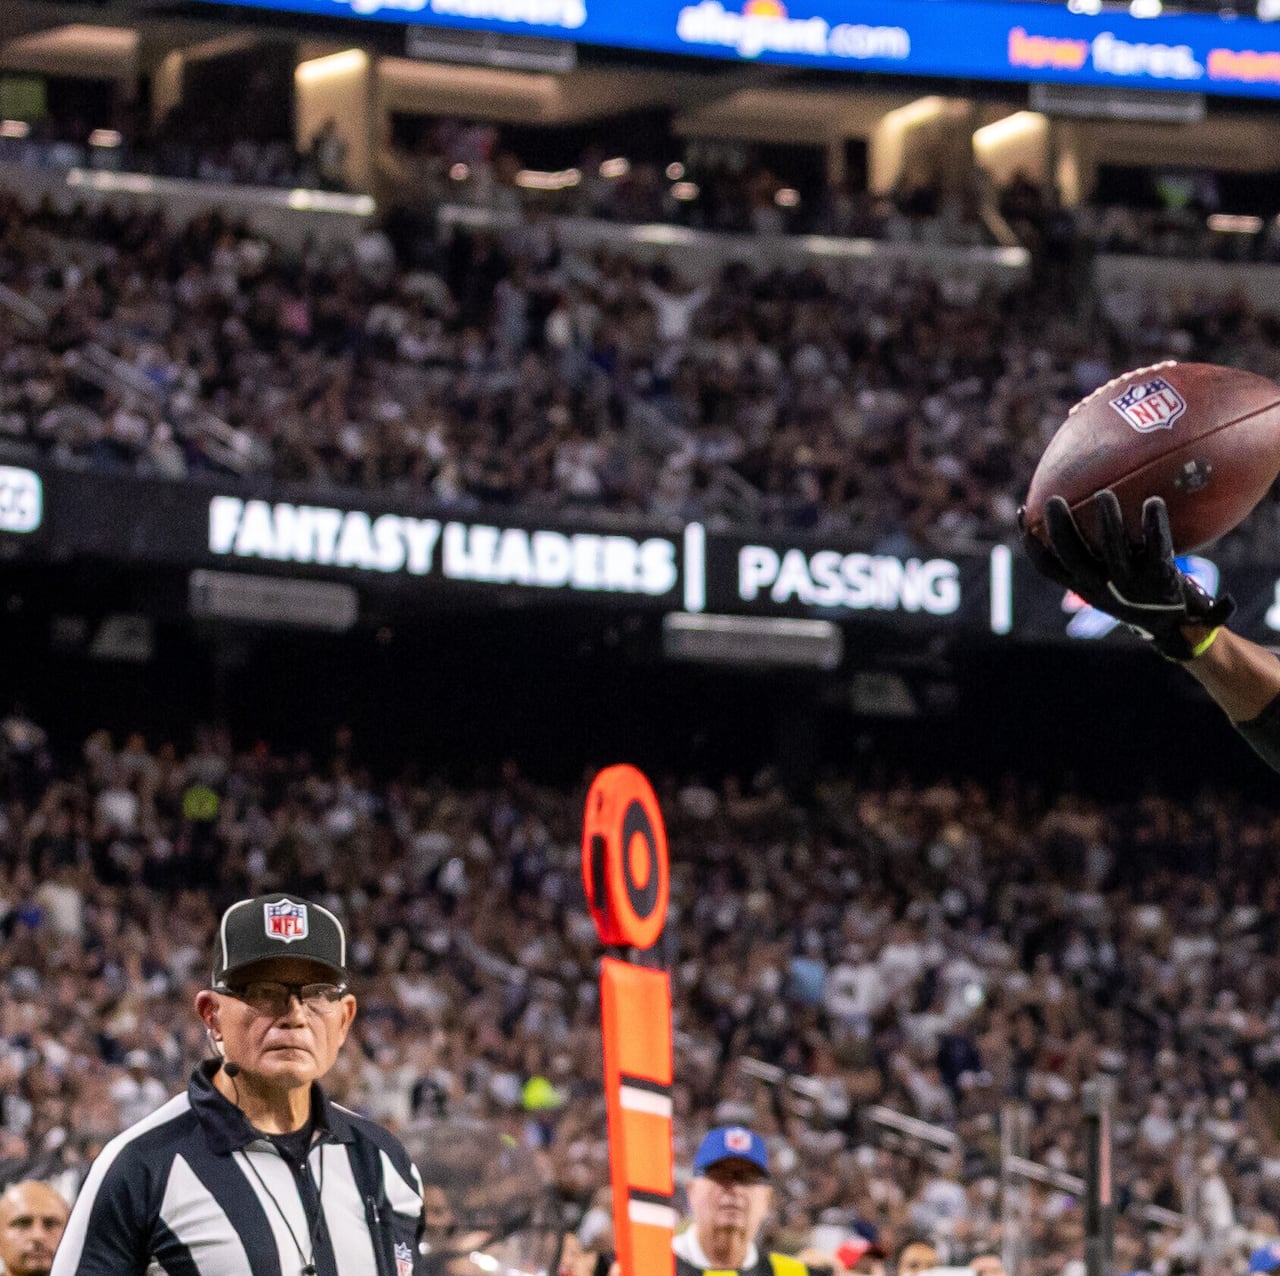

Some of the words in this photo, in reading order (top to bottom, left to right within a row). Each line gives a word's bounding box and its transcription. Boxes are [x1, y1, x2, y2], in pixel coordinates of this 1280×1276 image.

[1130, 391, 1179, 425] NFL
[209, 495, 441, 576] FANTASY
[442, 520, 677, 596] LEADERS
[738, 544, 962, 616] PASSING
[271, 915, 303, 936] NFL
